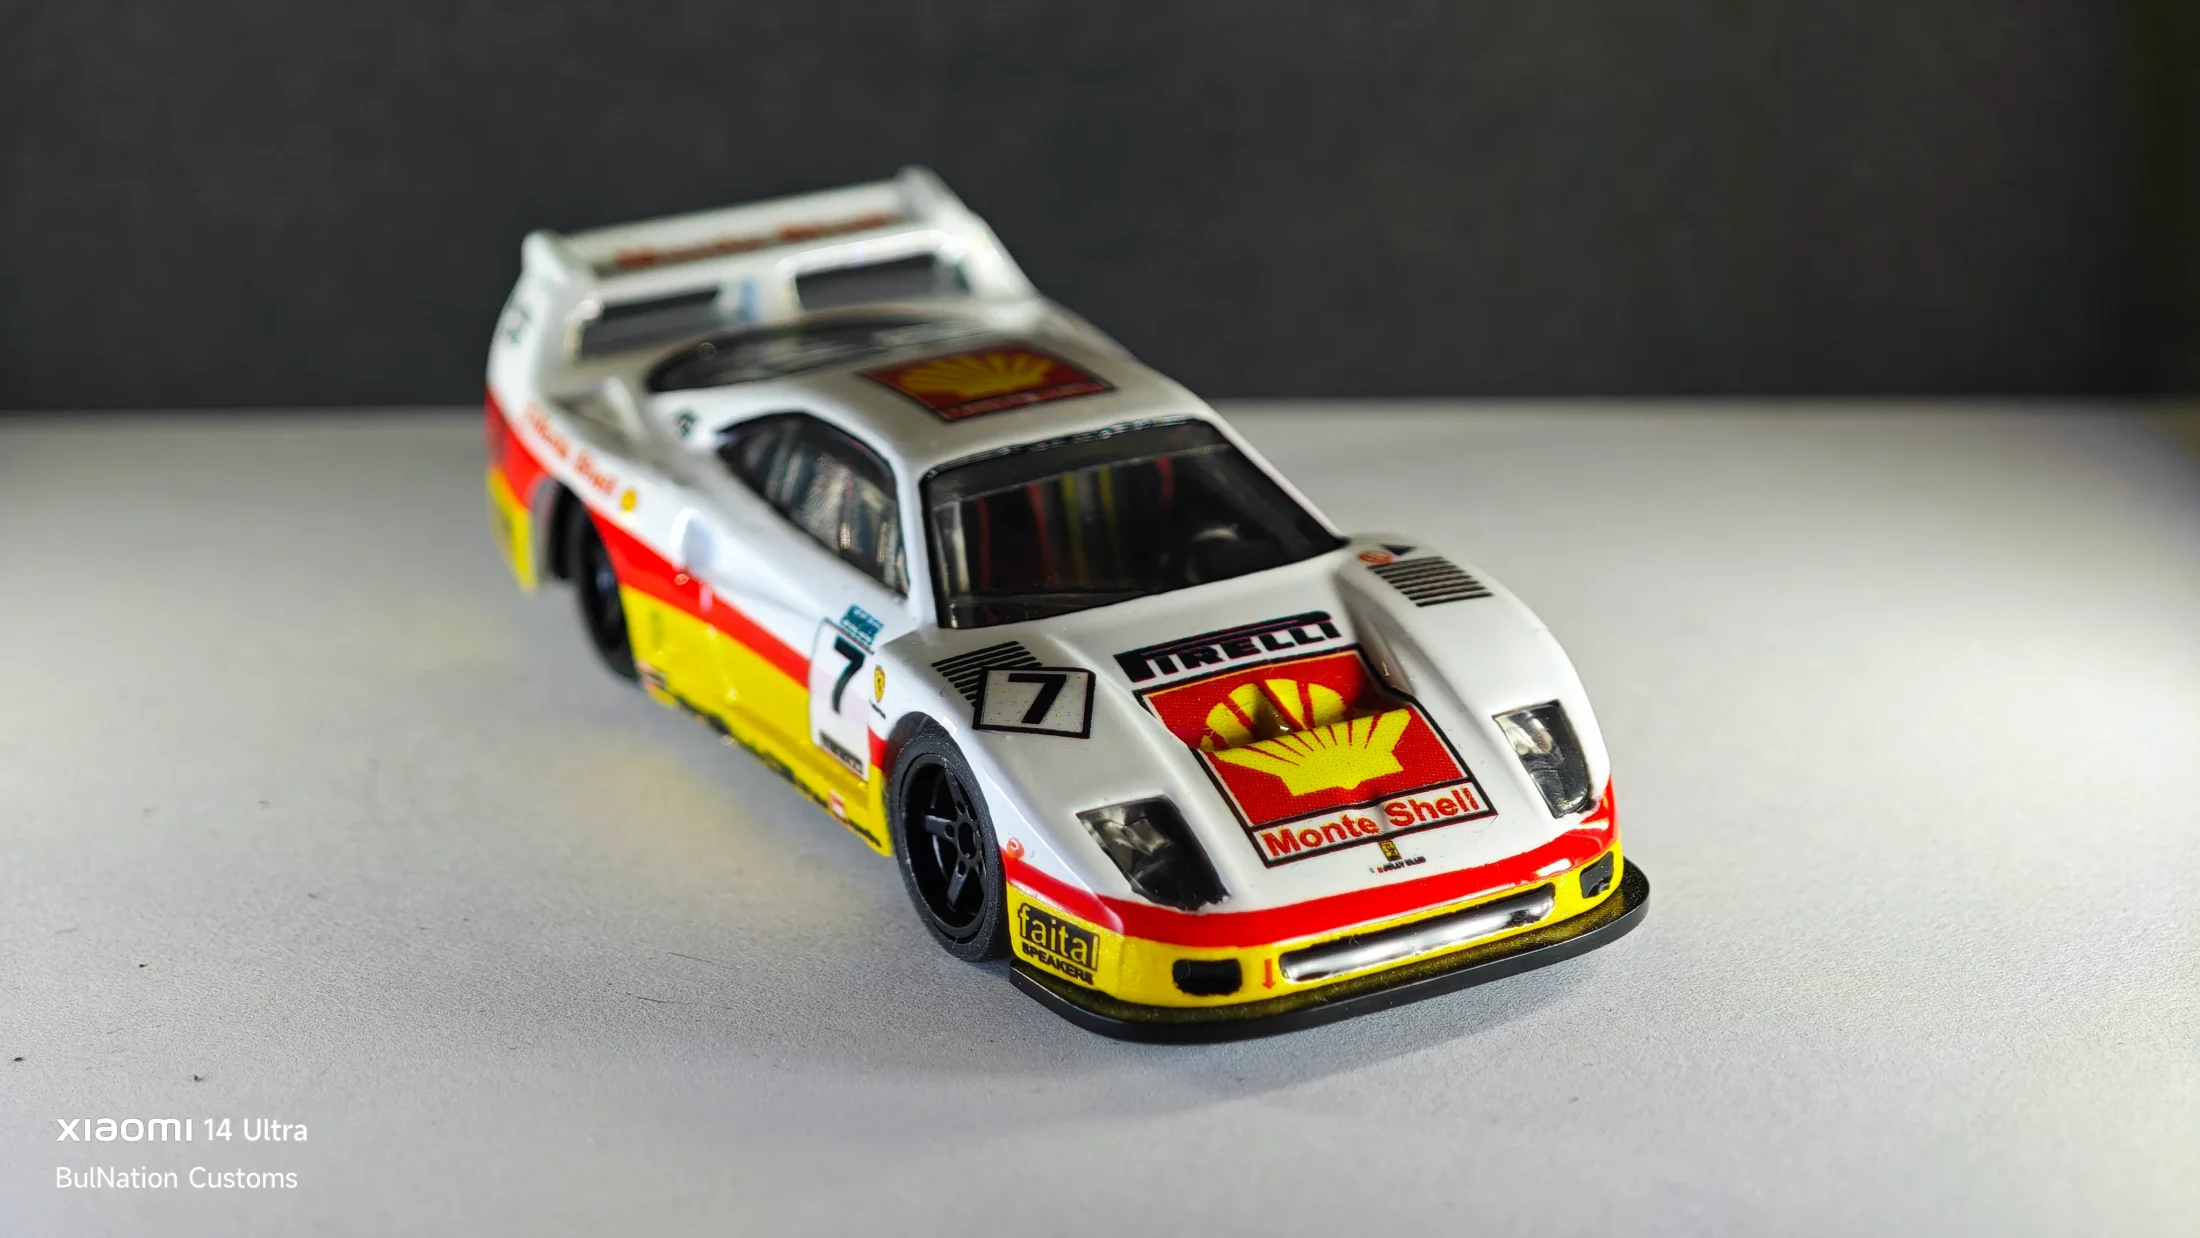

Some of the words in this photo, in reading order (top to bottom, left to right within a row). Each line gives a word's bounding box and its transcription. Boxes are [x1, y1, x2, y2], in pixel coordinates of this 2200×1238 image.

[833, 634, 865, 716] 7
[1113, 610, 1342, 683] PIRELLI
[1007, 673, 1069, 725] 7
[1261, 812, 1380, 857] Monte
[1384, 786, 1480, 828] Shell
[1018, 903, 1099, 970] faital
[1022, 941, 1094, 985] SPEAKERS
